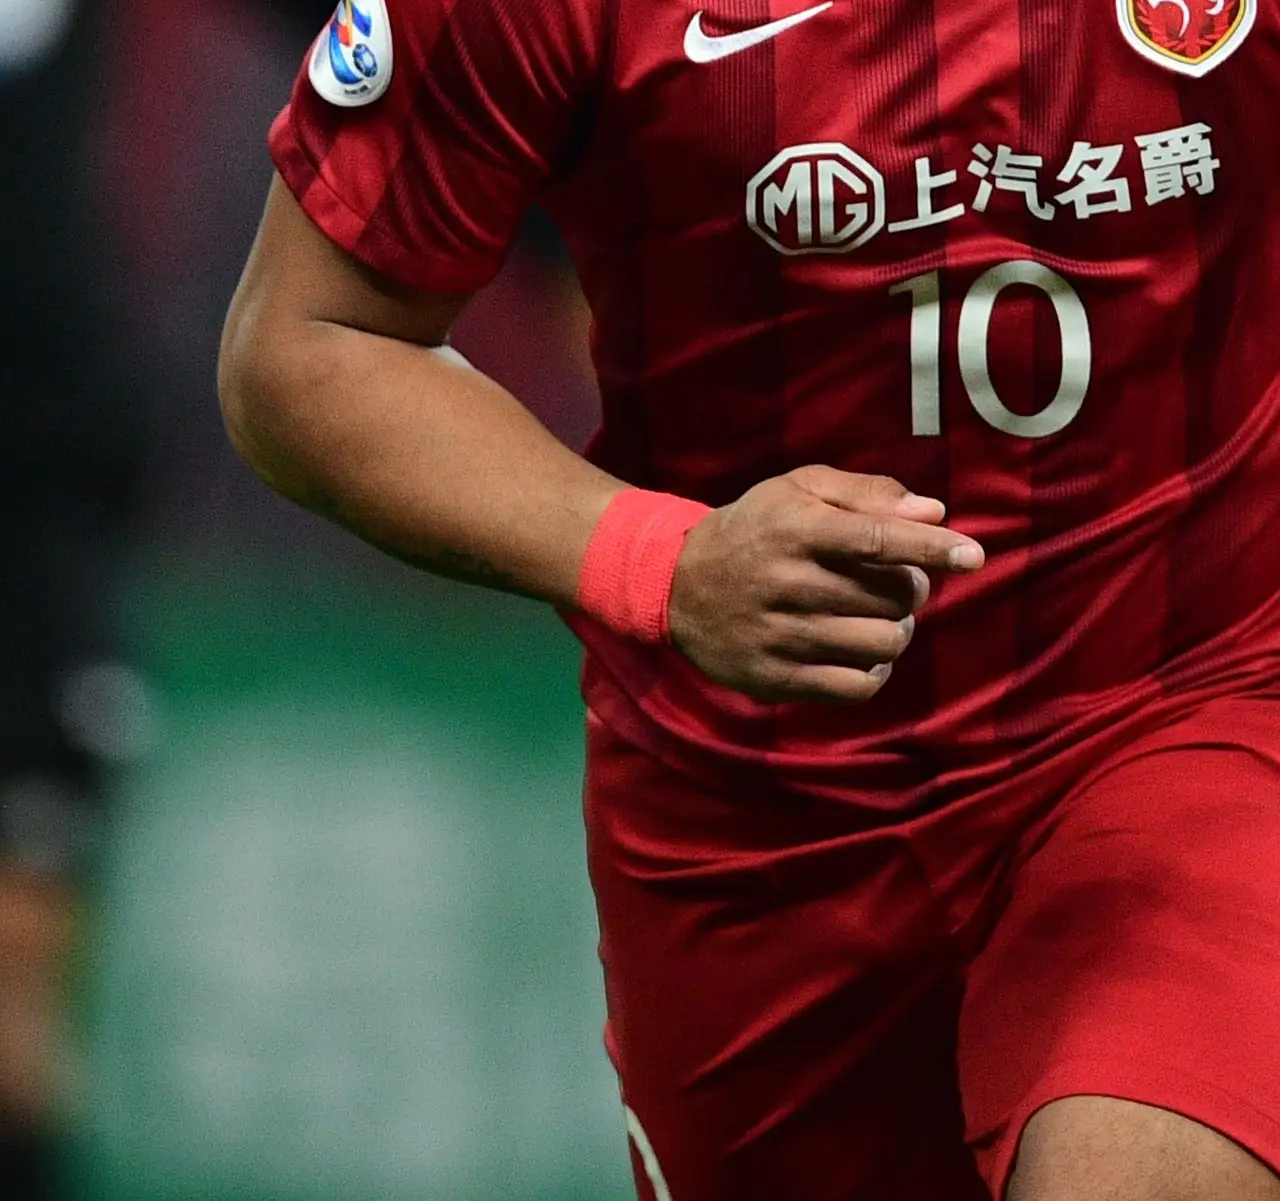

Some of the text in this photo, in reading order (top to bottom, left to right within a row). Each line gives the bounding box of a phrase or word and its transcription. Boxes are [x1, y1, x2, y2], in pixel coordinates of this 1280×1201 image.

[762, 159, 869, 245] MG
[888, 123, 1219, 233] 上汽名爵
[889, 259, 1091, 438] 10
